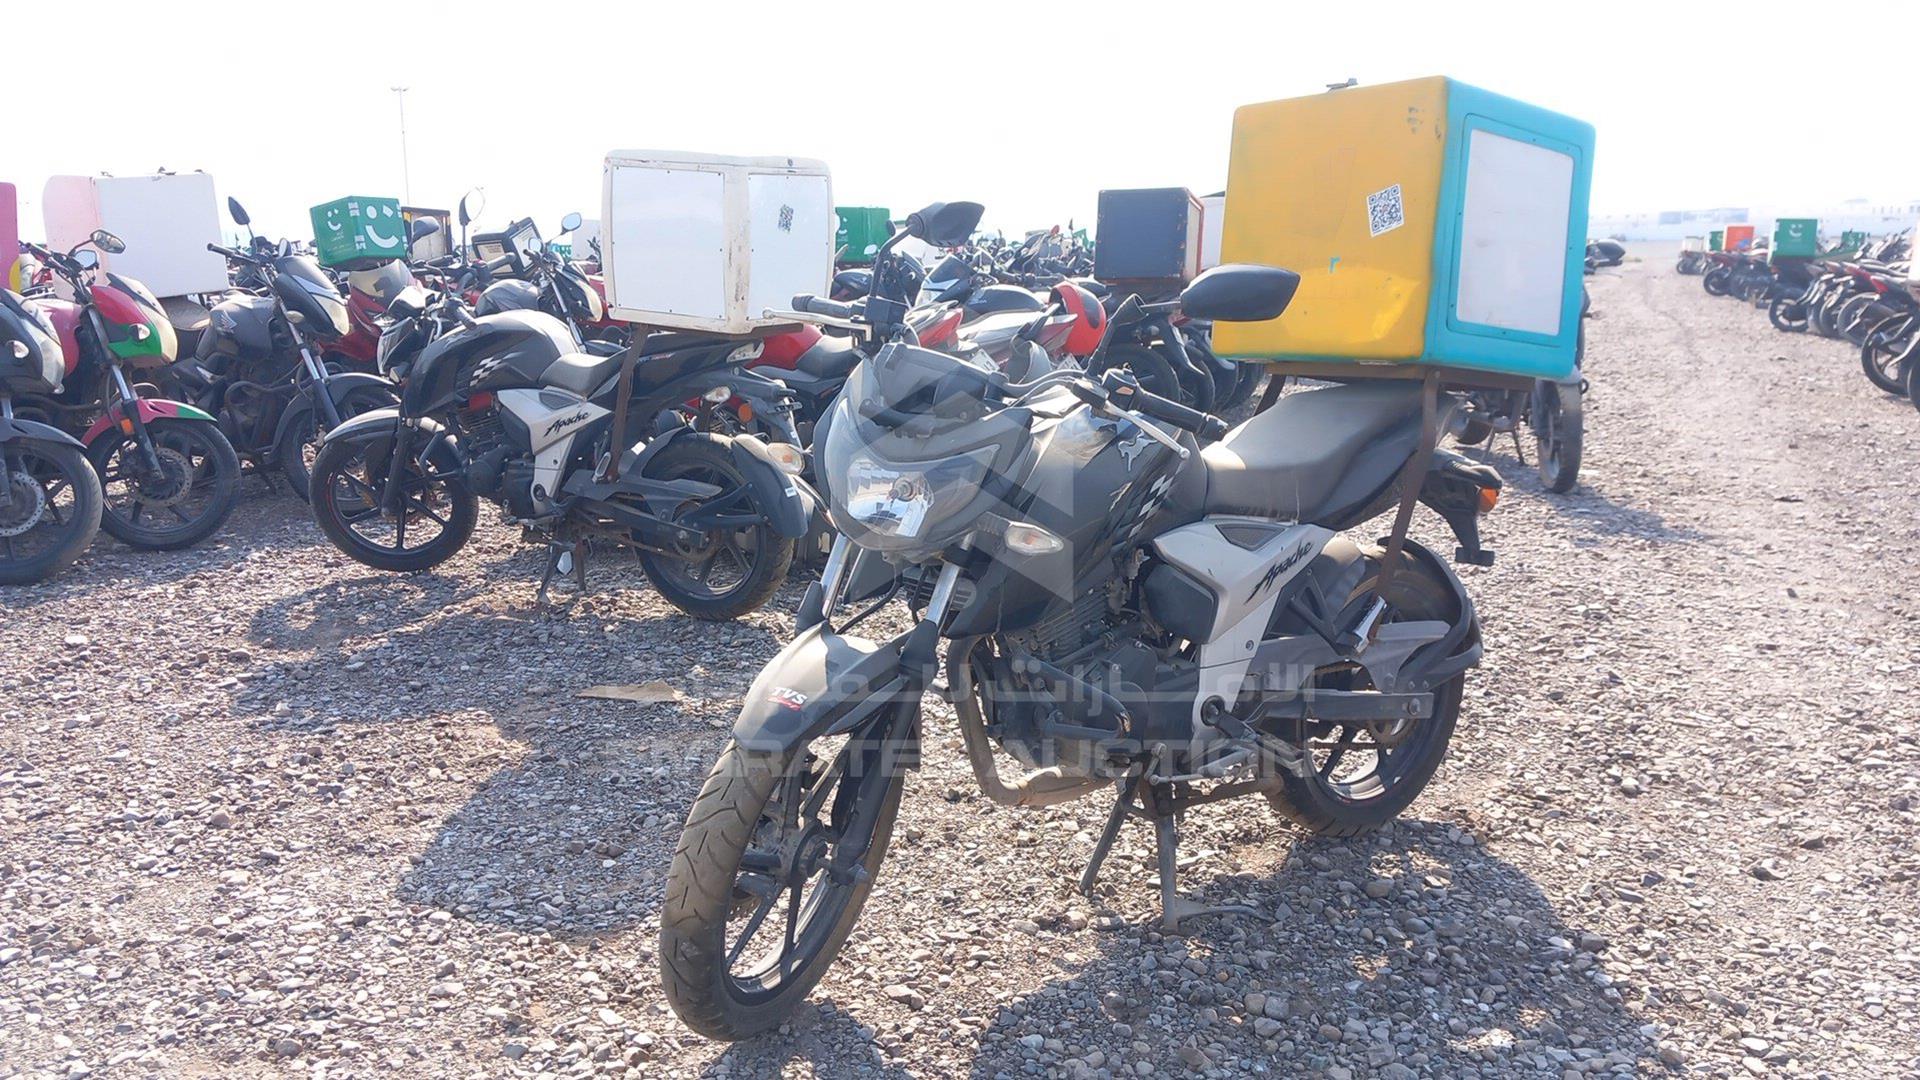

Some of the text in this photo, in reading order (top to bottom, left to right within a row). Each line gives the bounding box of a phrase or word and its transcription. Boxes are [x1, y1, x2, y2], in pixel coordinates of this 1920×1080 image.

[543, 410, 589, 437] Apache
[1242, 540, 1314, 605] Apache
[771, 686, 808, 705] TVS
